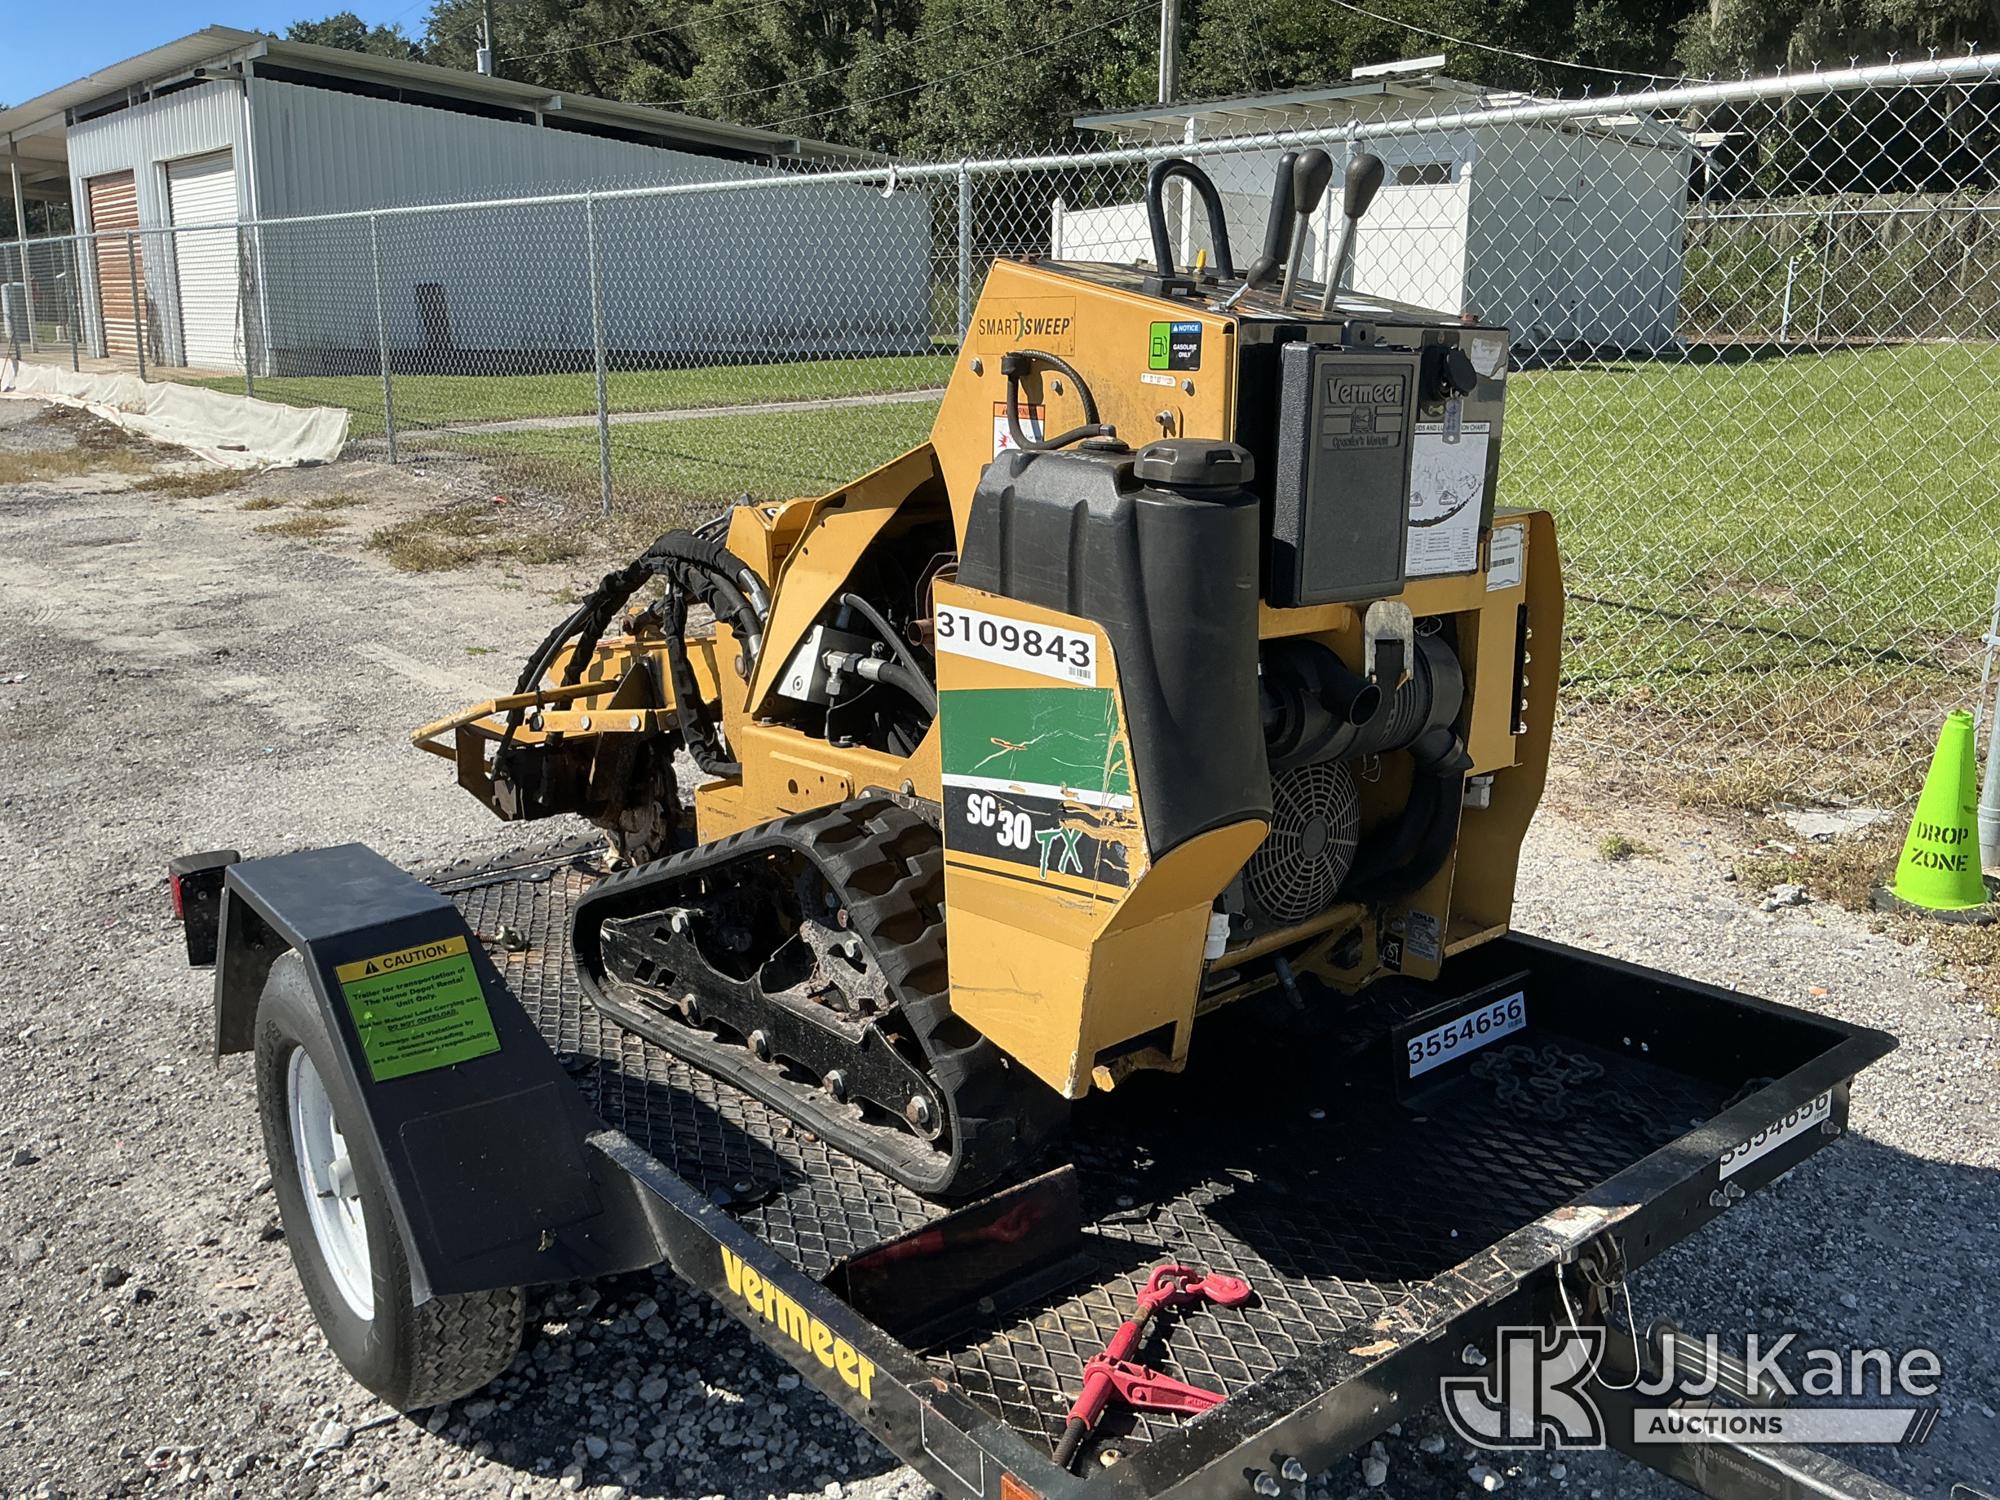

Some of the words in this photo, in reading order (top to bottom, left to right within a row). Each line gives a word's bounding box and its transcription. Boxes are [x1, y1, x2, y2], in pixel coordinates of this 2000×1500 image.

[978, 318, 1018, 336] SMART
[1024, 317, 1070, 335] SWEEP
[1328, 378, 1401, 404] Vermeer
[936, 611, 1091, 668] 3109843
[1917, 822, 1968, 845] DROP
[1035, 826, 1083, 880] TX
[1911, 848, 1968, 871] ZONE
[383, 944, 448, 969] CAUTION
[353, 989, 380, 999] Trailer
[381, 985, 394, 993] for
[397, 970, 456, 989] transportation
[364, 997, 380, 1006] The
[382, 991, 407, 1001] Home
[409, 984, 434, 995] Depot
[436, 977, 463, 986] Rental
[396, 998, 414, 1007] Unit
[1409, 999, 1522, 1064] 3554656
[721, 1245, 875, 1400] Vermeer
